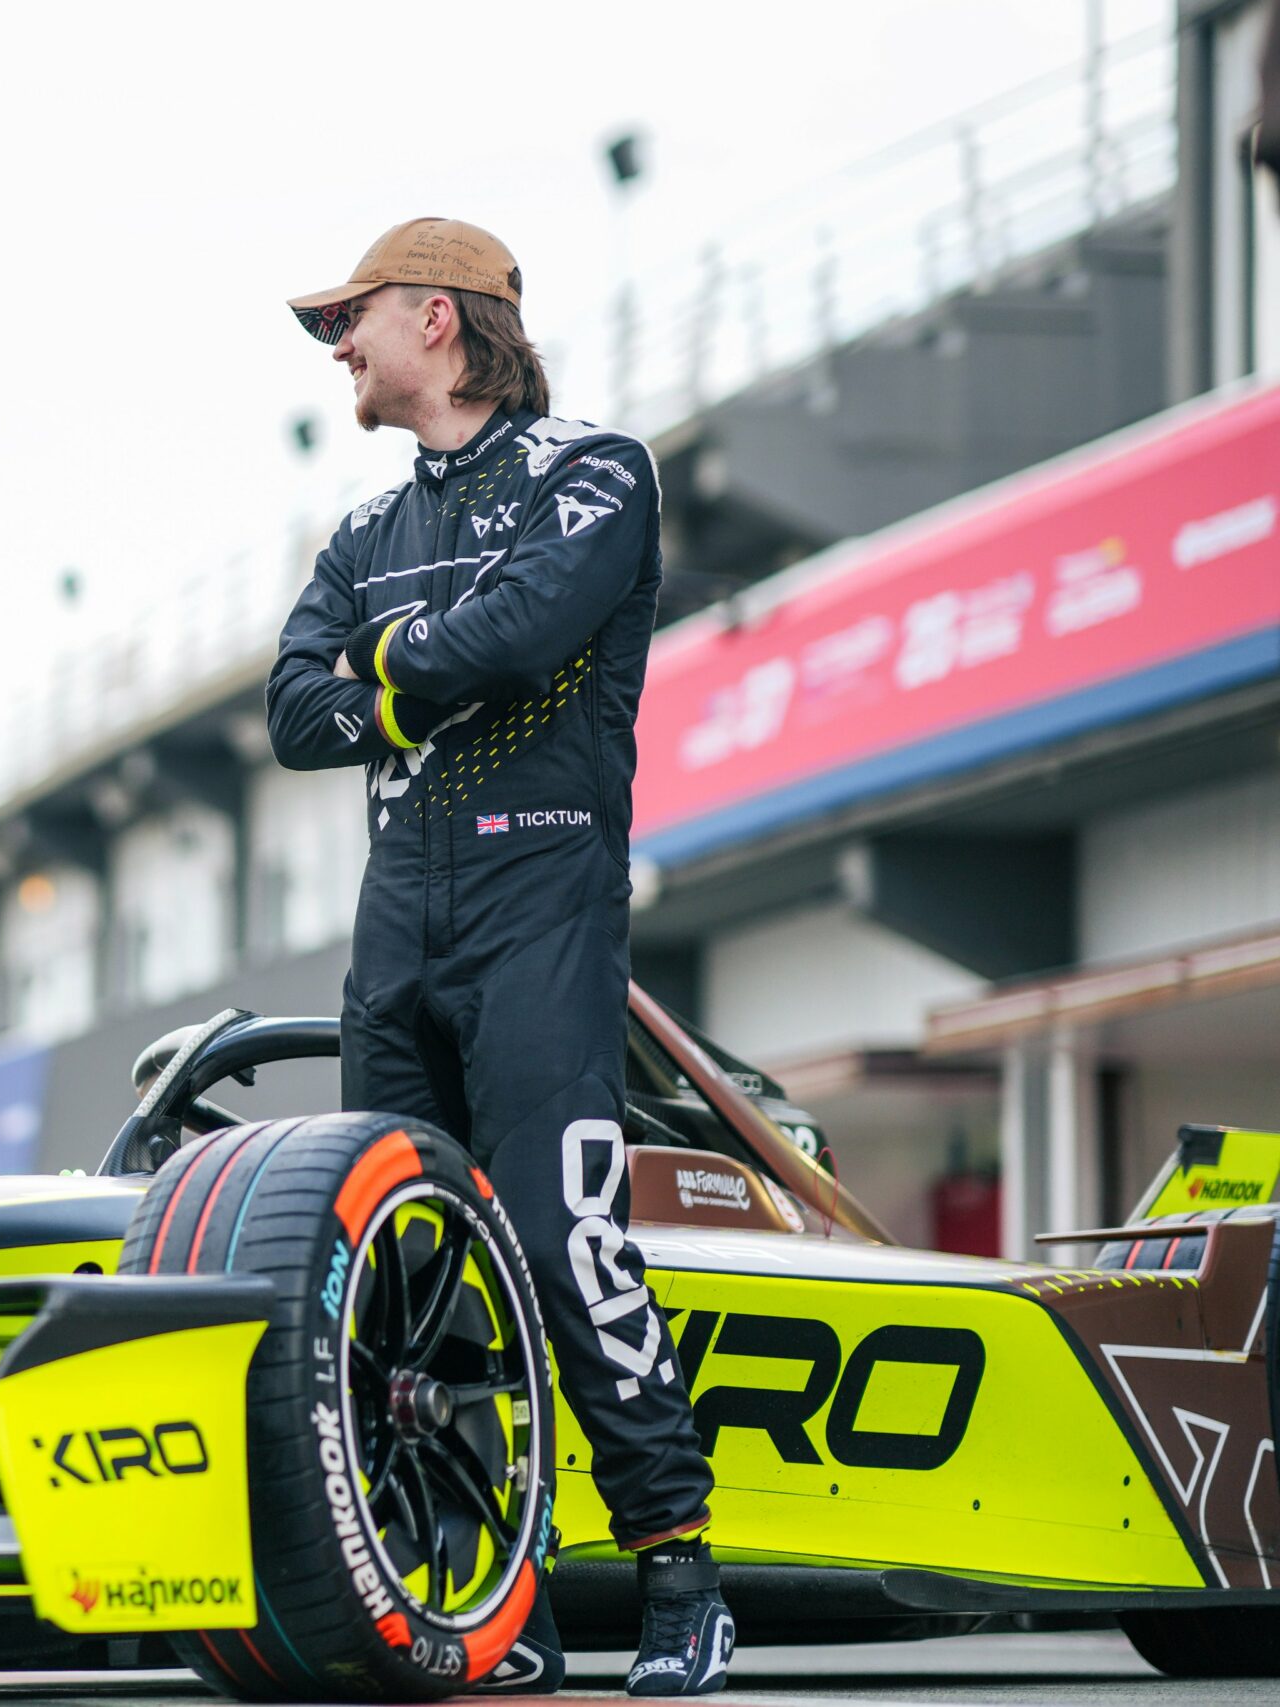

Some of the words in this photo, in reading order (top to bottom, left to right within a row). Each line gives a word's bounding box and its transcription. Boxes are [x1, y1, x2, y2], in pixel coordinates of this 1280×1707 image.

[455, 420, 513, 466] CUPRA
[516, 810, 591, 828] TICKTUM
[663, 1307, 987, 1471] IRO
[32, 1420, 209, 1488] KIRO
[628, 1659, 686, 1684] OMP
